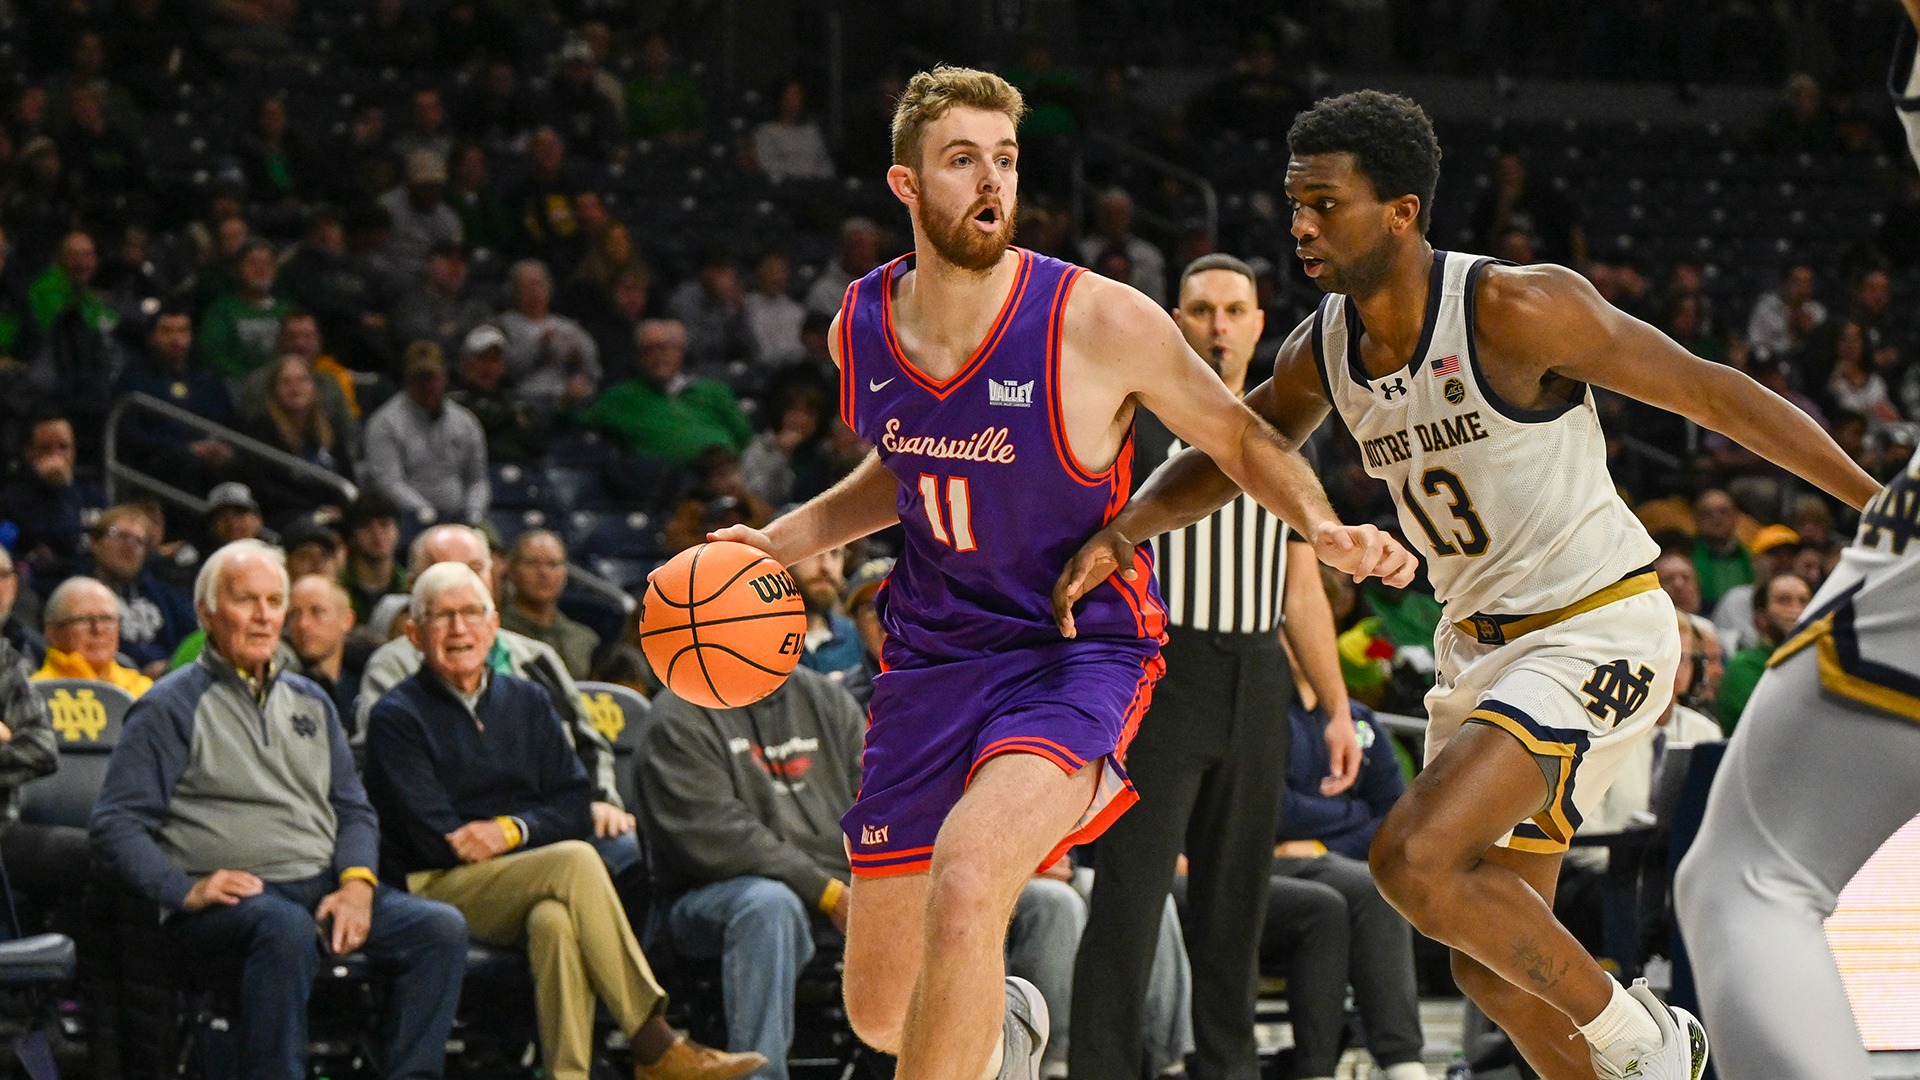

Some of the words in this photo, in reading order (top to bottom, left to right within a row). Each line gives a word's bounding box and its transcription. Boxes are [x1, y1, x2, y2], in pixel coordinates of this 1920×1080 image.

[988, 378, 1034, 403] VALLEY
[881, 417, 1017, 464] Evansville
[1361, 429, 1413, 469] NOTRE
[1413, 410, 1490, 453] DAME
[917, 472, 978, 552] 11
[1402, 466, 1492, 558] 13
[778, 632, 806, 655] EV
